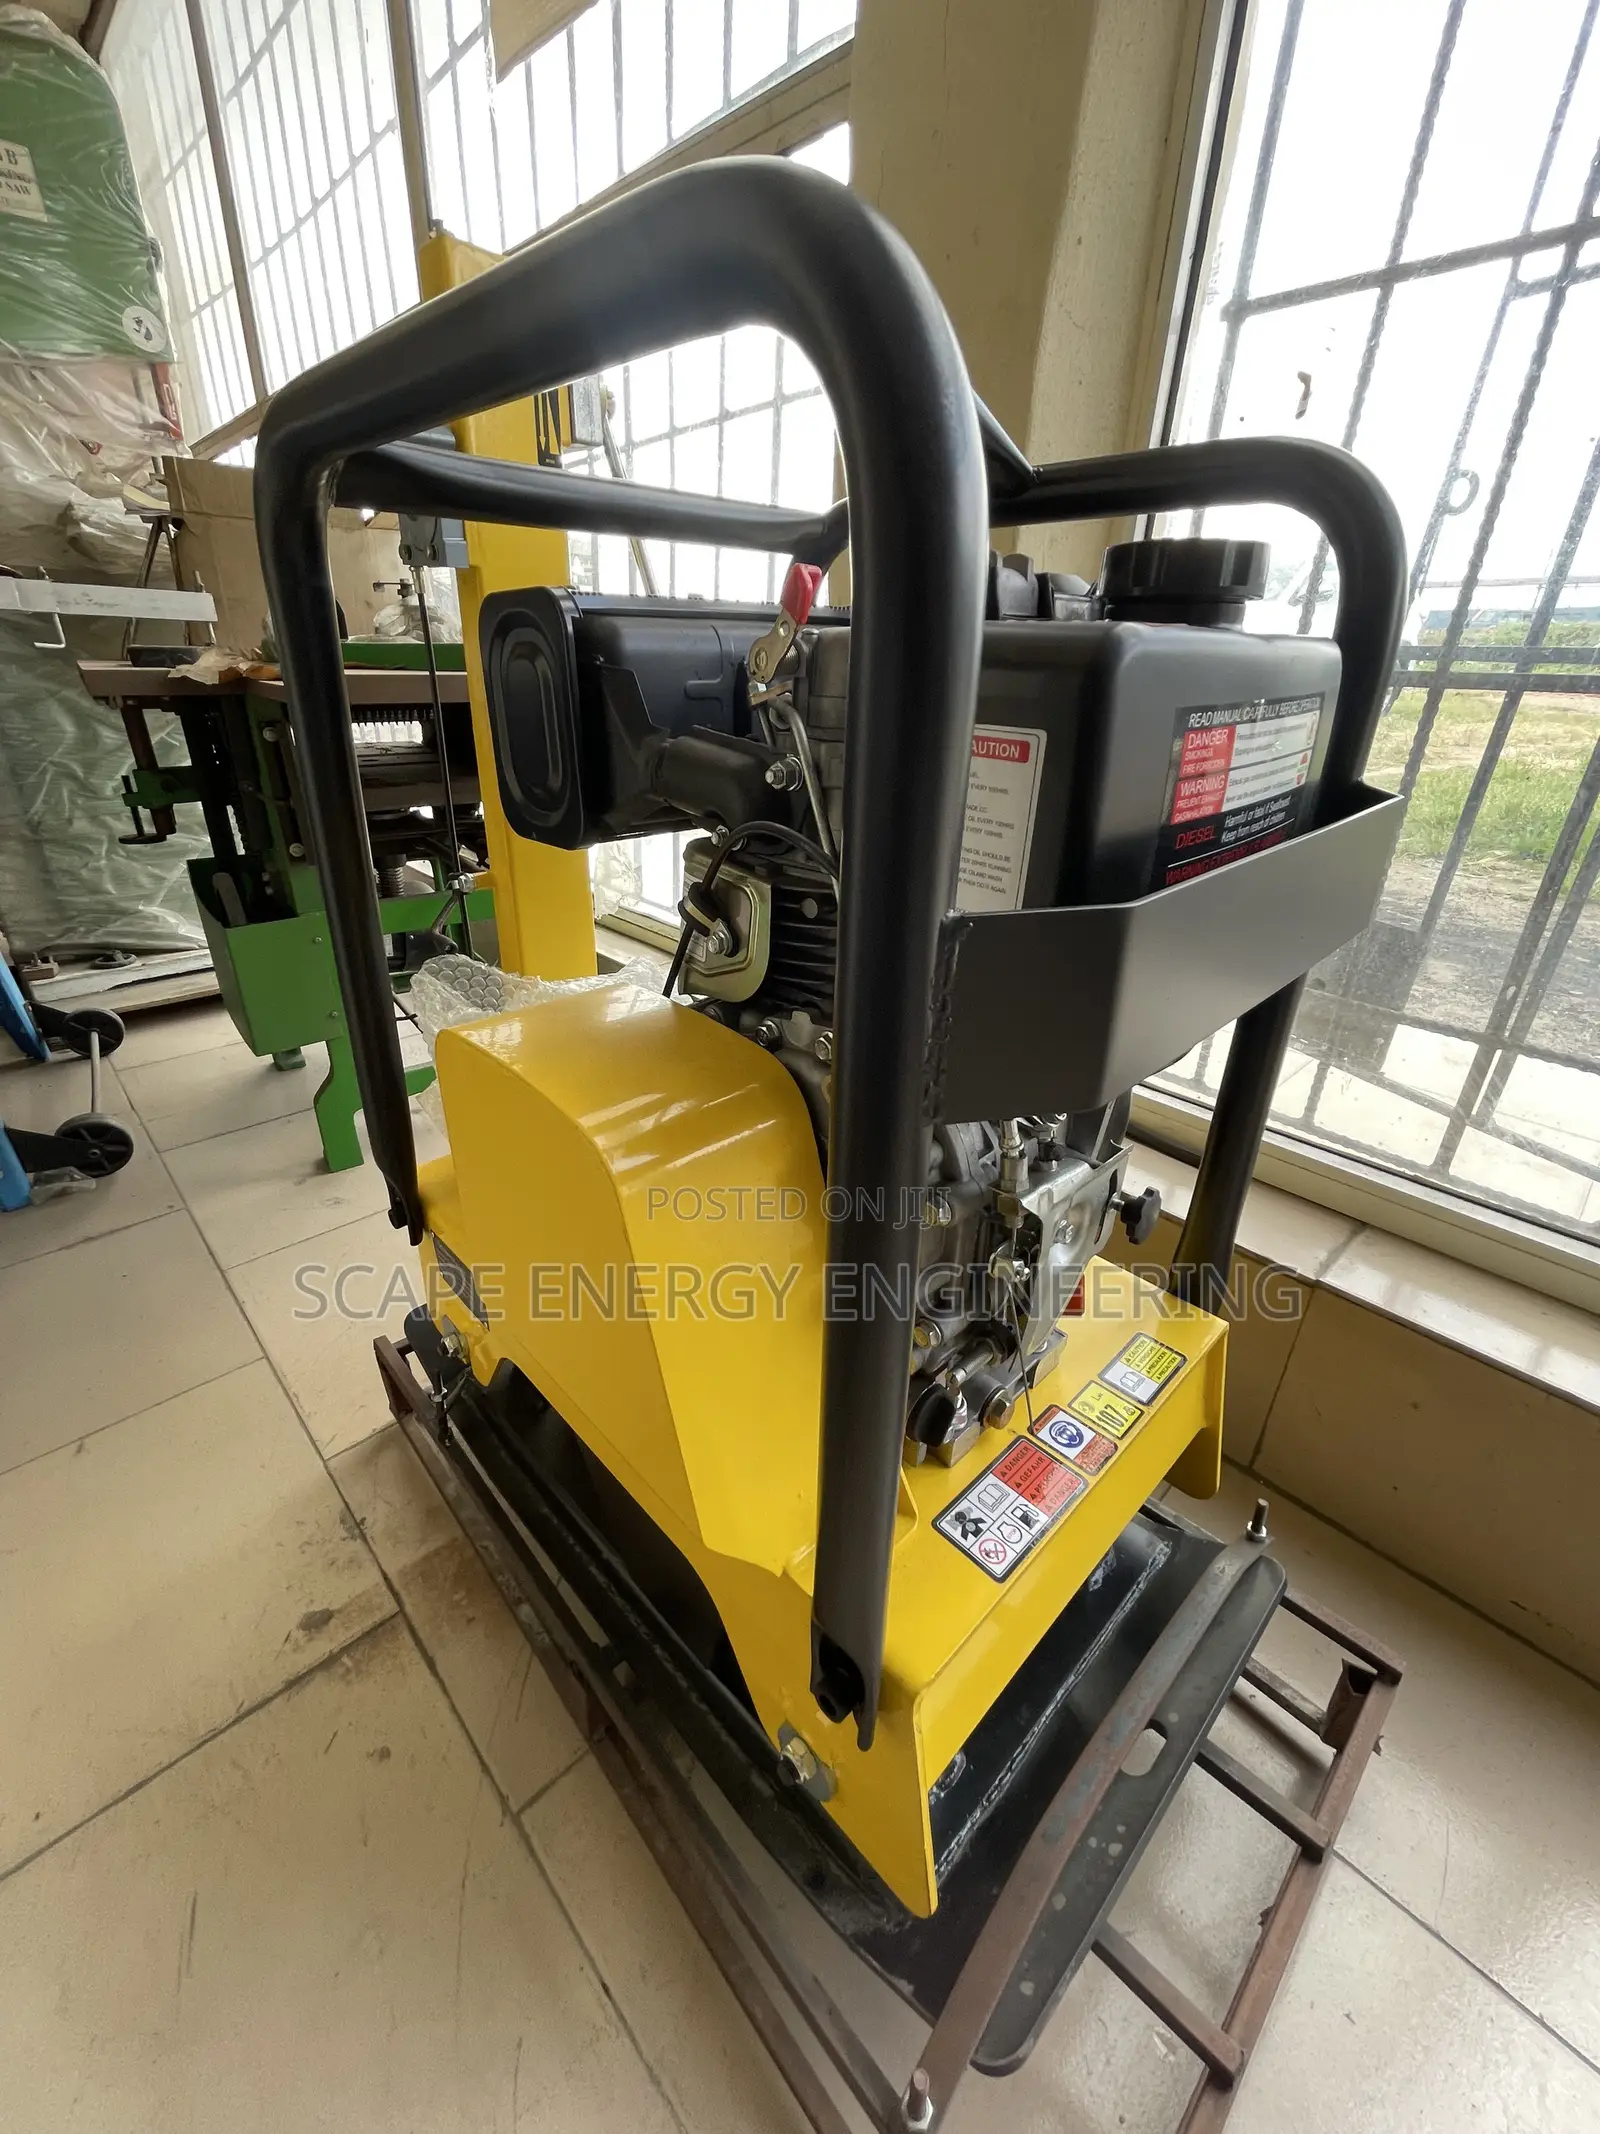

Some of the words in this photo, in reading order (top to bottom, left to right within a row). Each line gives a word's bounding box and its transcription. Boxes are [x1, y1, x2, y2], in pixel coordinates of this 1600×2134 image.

[1188, 711, 1213, 728] READ
[1212, 707, 1241, 725] MANUAL
[972, 740, 1020, 758] AUTION
[1188, 729, 1229, 749] DANGER
[1180, 774, 1226, 797] WARNING
[1175, 825, 1216, 850] DIESEL
[1221, 830, 1237, 844] Keep
[1095, 1403, 1129, 1433] 107
[1005, 1446, 1030, 1472] DANGER
[1020, 1456, 1045, 1482] GEFAHR
